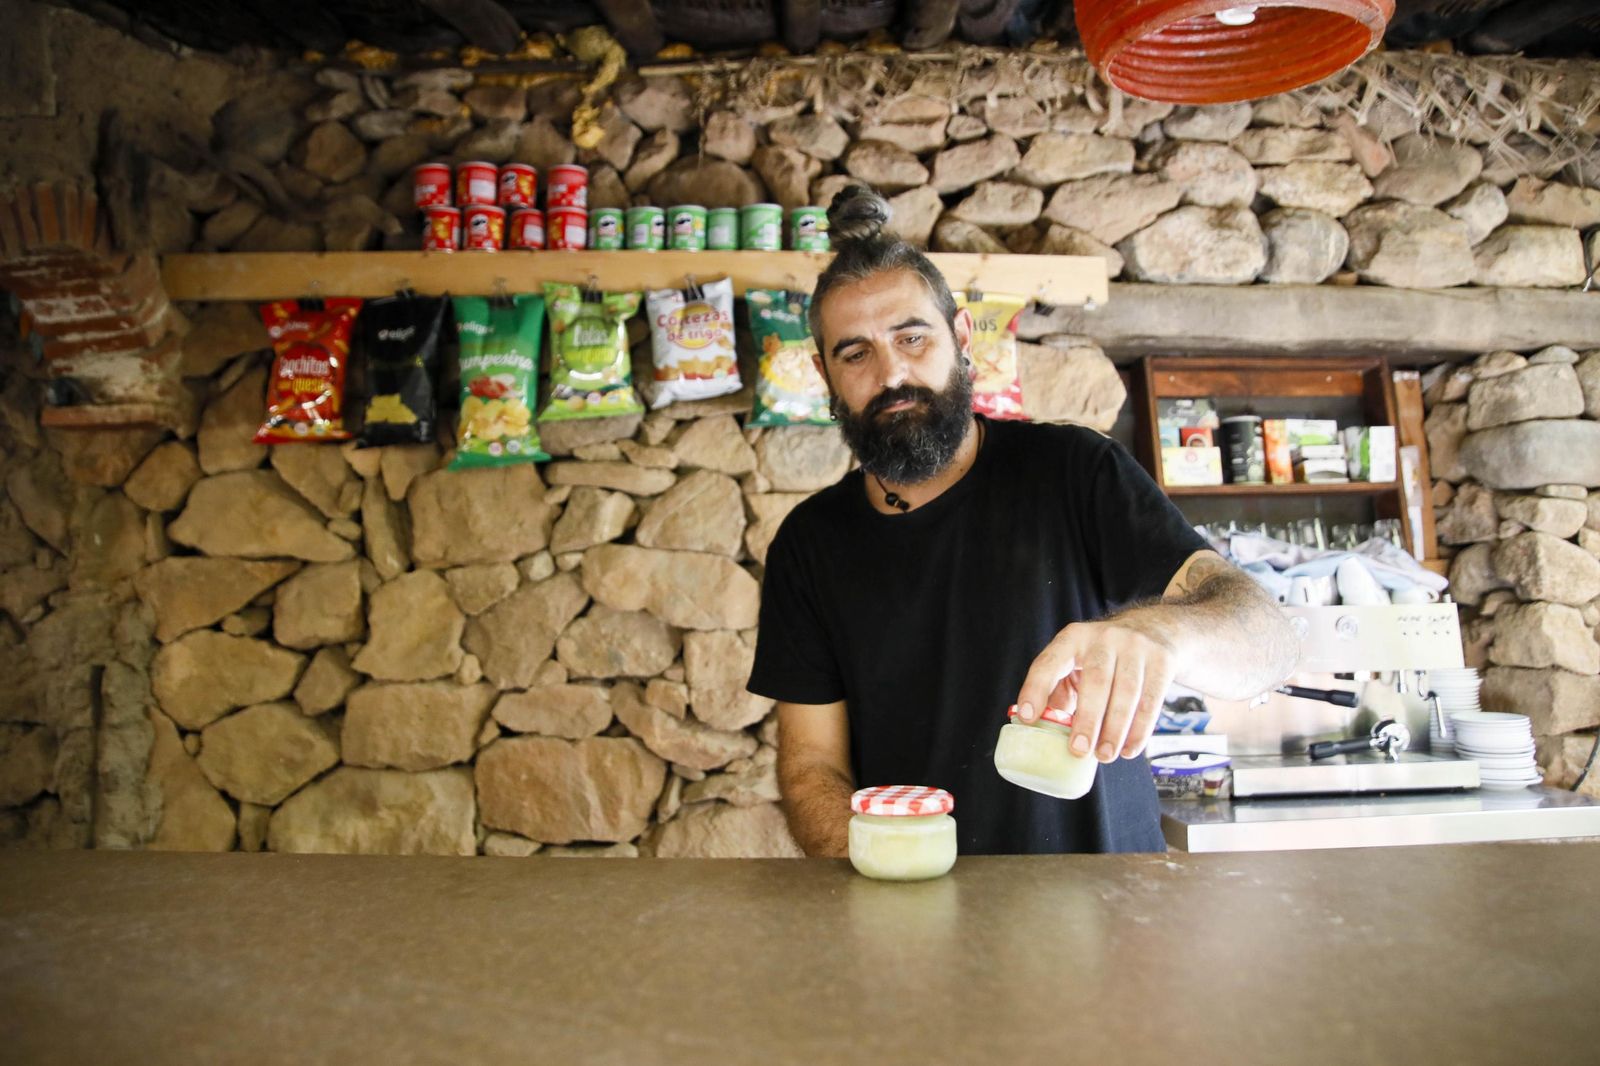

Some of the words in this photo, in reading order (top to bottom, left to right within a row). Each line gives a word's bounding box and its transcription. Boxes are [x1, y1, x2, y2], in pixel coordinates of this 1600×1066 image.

[657, 310, 729, 328] Cortezas
[667, 331, 684, 342] de
[687, 328, 723, 340] trigo
